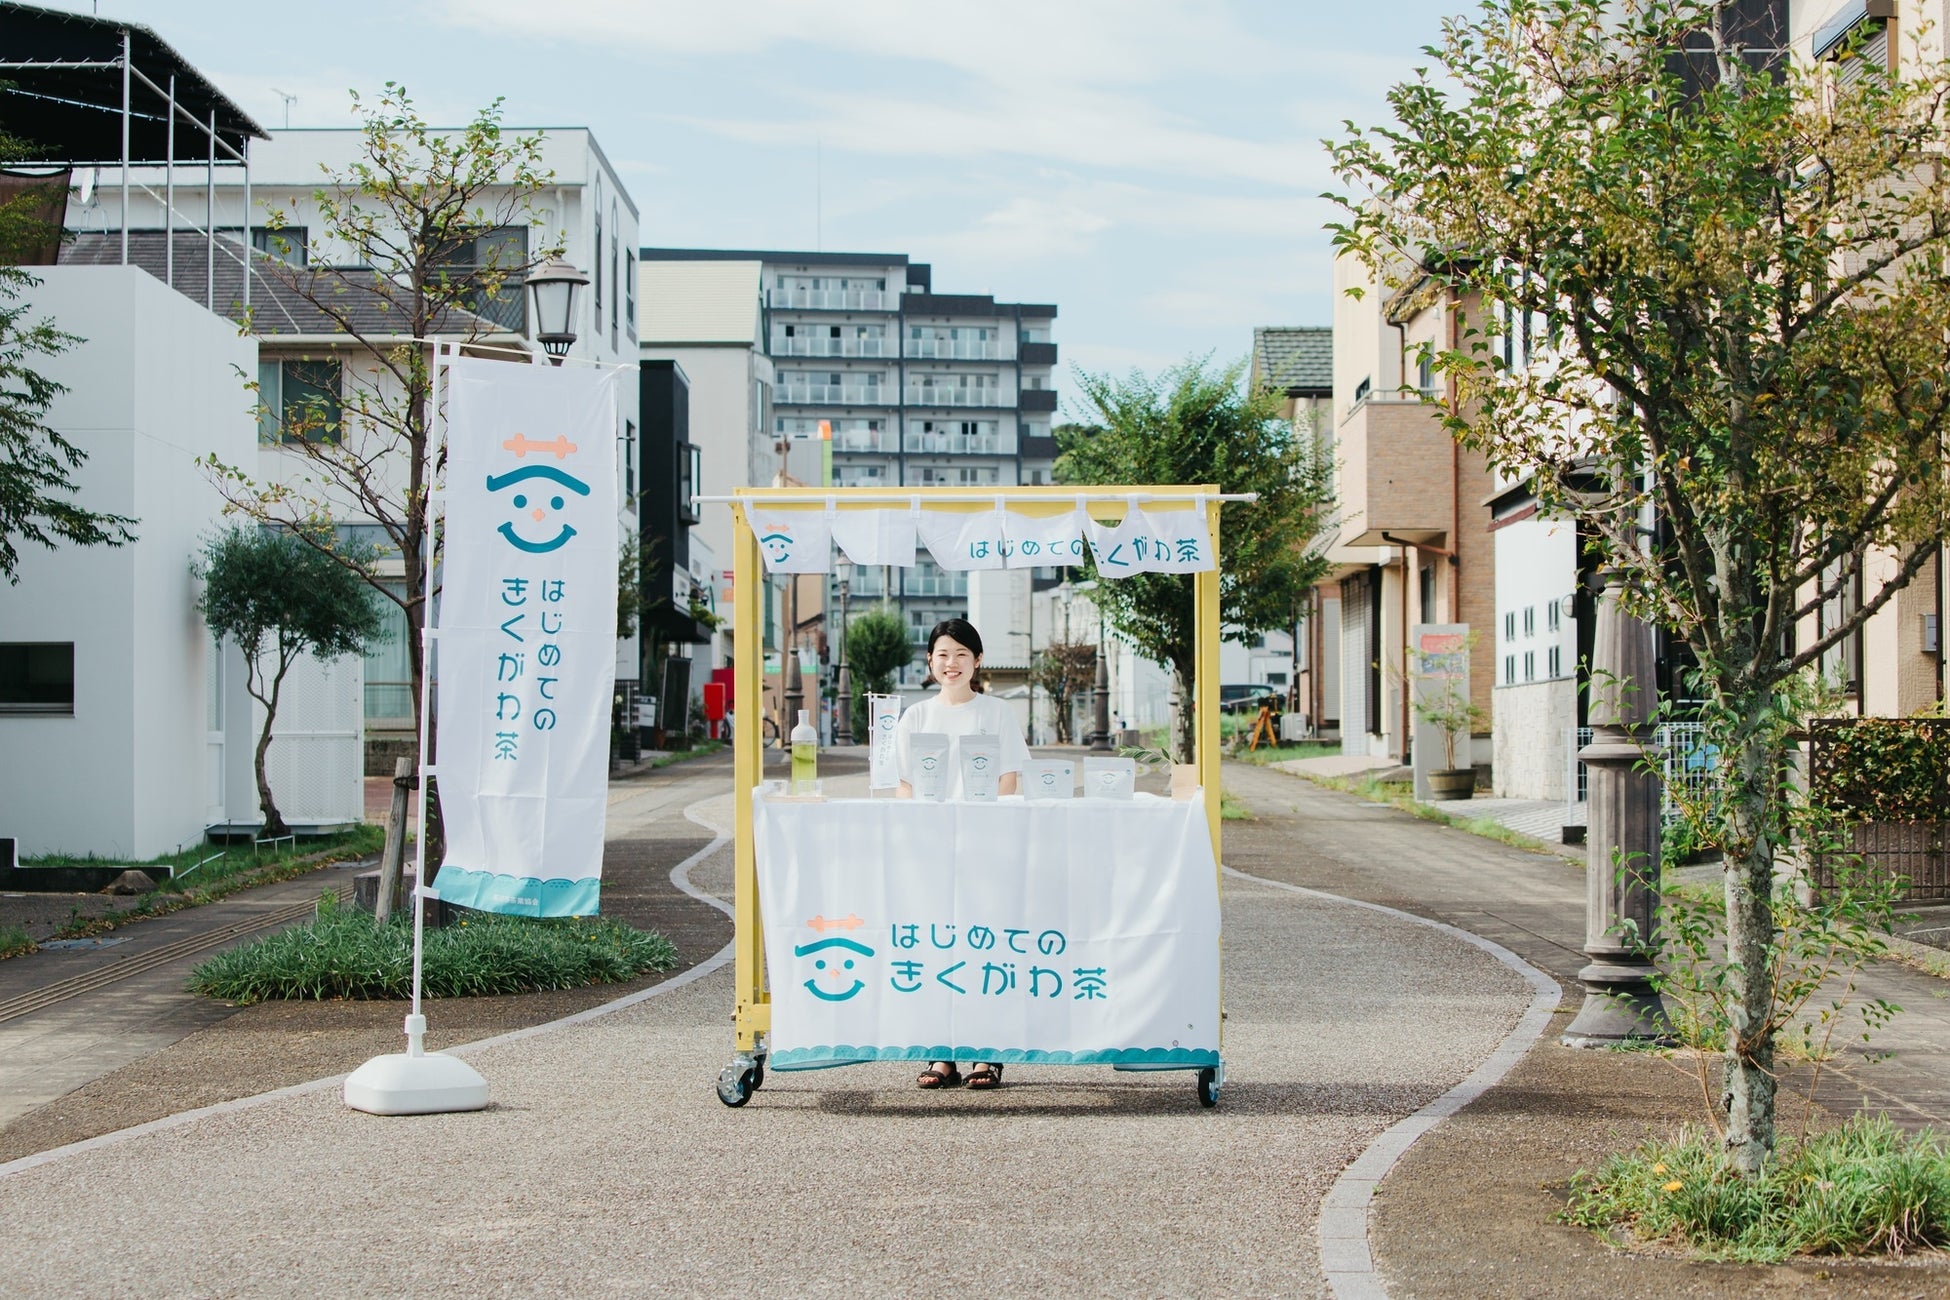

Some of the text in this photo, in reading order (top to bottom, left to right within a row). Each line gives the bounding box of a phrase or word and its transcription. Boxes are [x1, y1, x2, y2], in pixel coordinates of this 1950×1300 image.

[494, 576, 530, 762] きくがわ茶
[532, 578, 566, 732] はじめての
[890, 960, 1108, 1001] きくがわ茶
[891, 923, 1068, 956] はじめての
